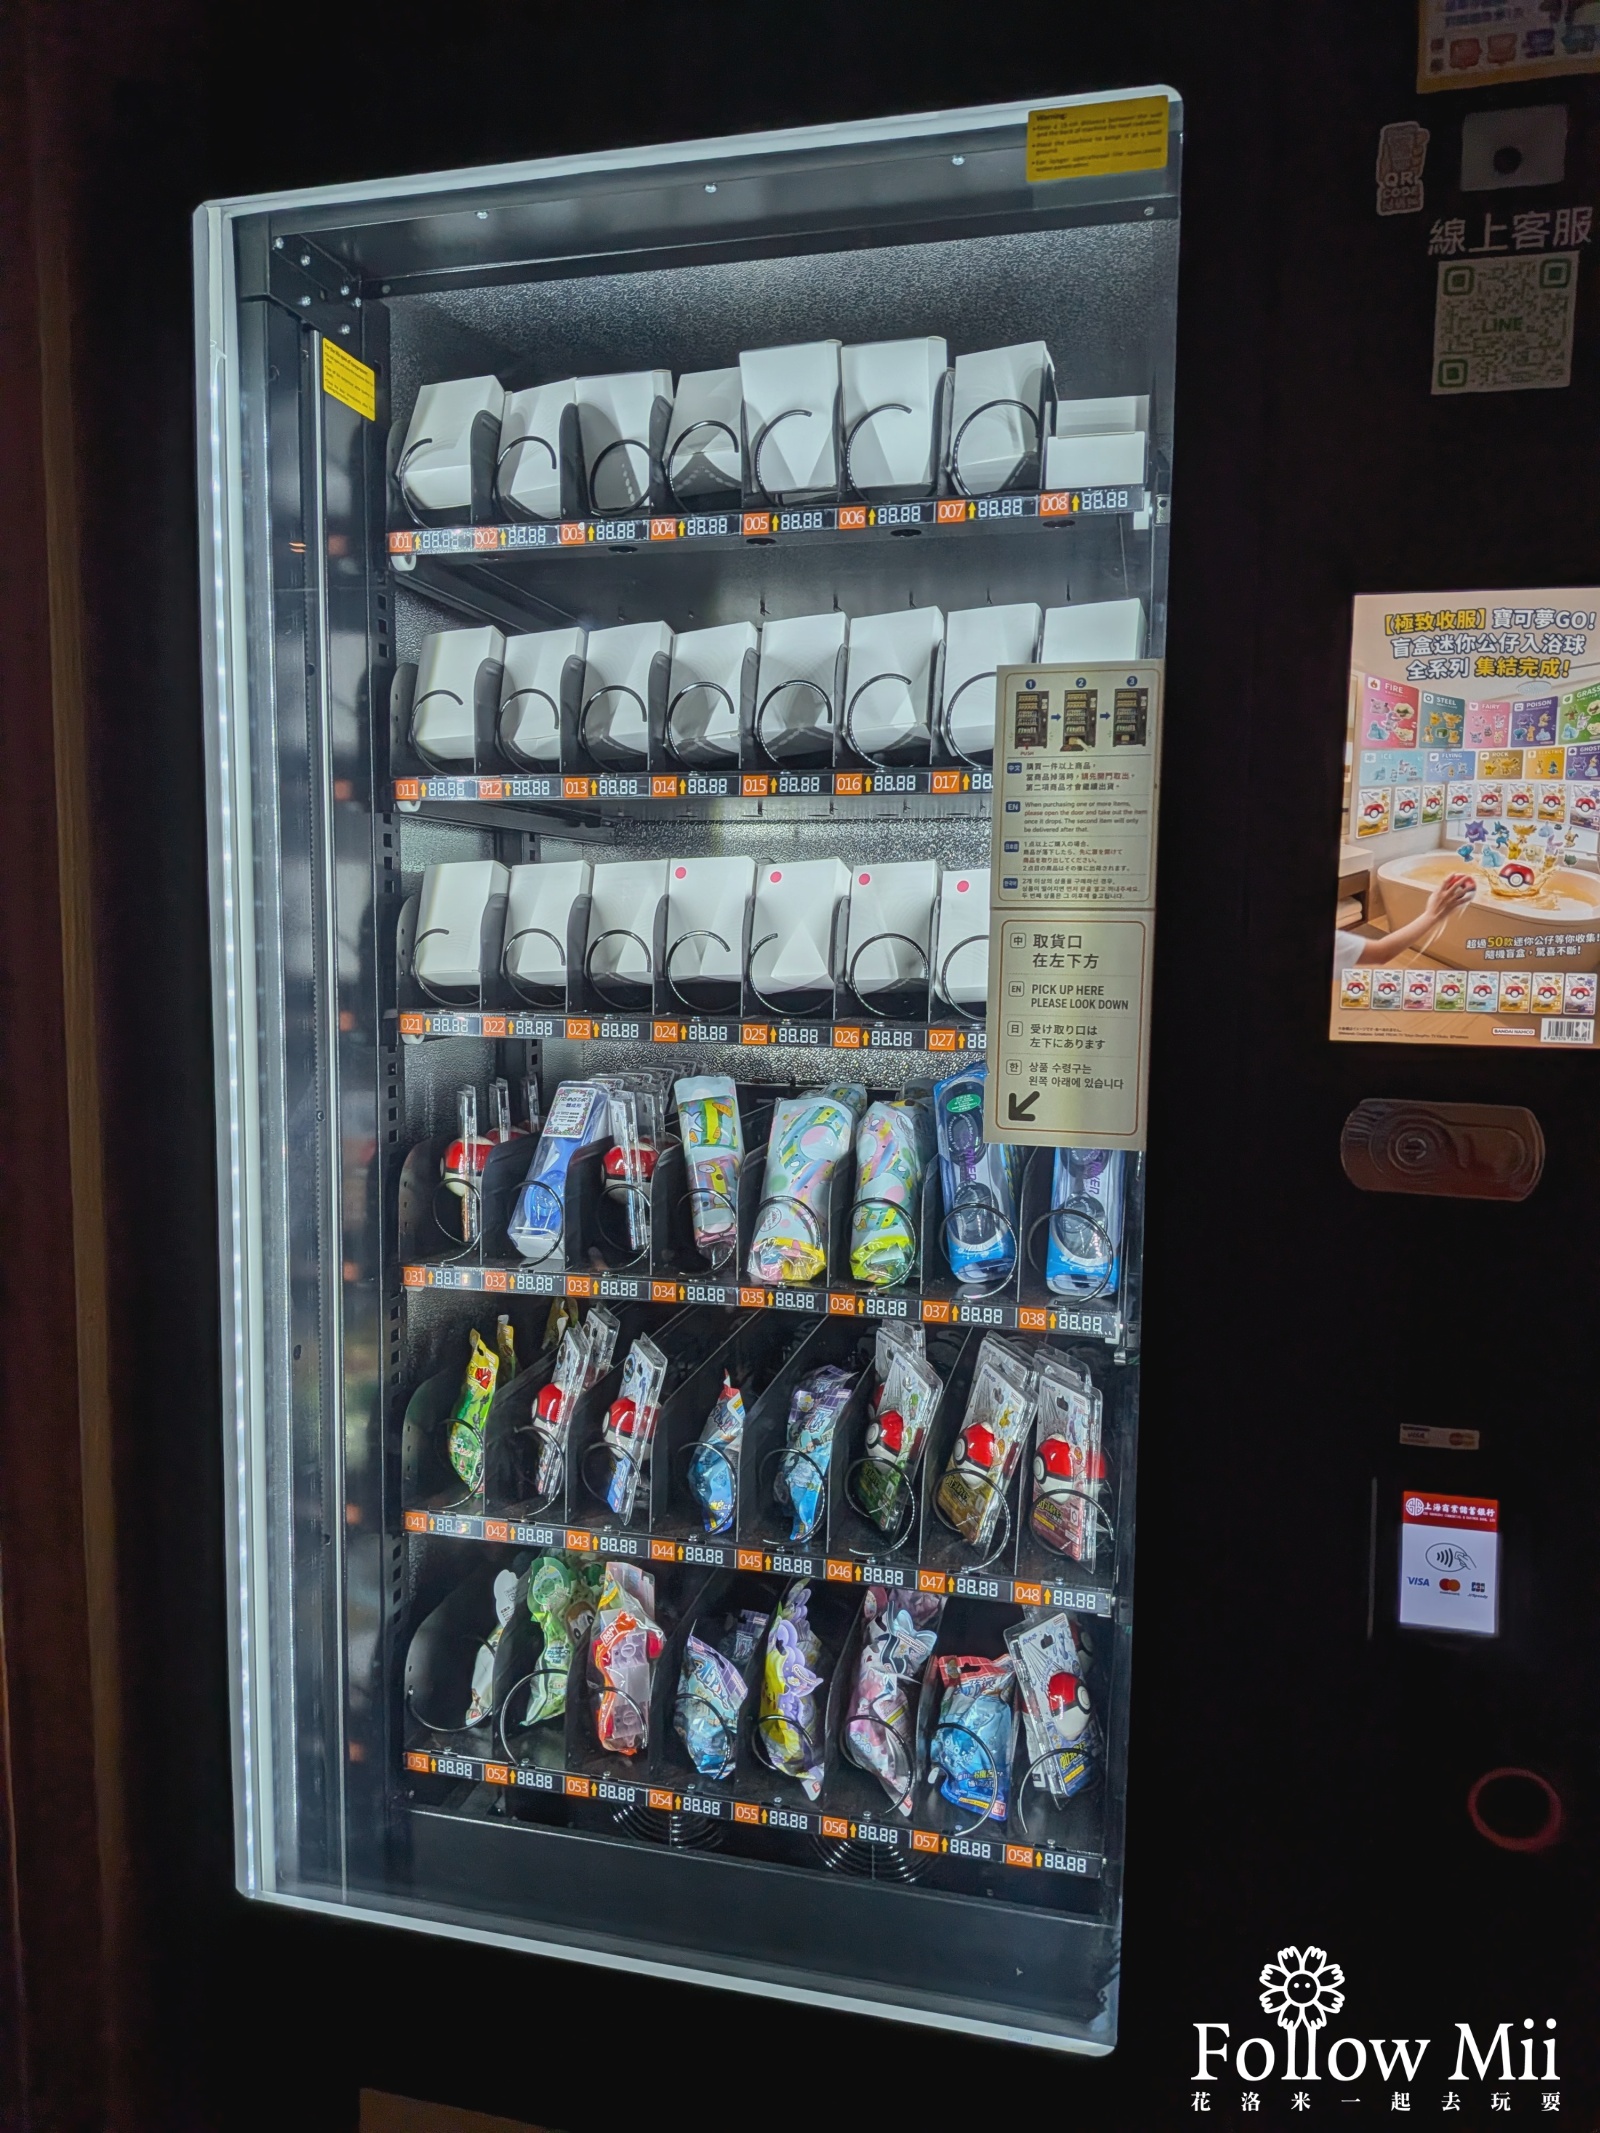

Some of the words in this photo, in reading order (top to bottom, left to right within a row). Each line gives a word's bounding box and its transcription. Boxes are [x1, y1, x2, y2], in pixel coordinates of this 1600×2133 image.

[1385, 172, 1415, 187] QR
[1428, 206, 1593, 256] 線上客服
[1482, 316, 1523, 333] LINE
[1042, 497, 1067, 511] 008
[1082, 491, 1127, 510] 88.88
[939, 504, 963, 519] 007
[978, 499, 1022, 517] 88.88
[745, 517, 768, 530] 005
[781, 513, 822, 530] 88.88
[840, 511, 864, 526] 006
[562, 526, 584, 541] 003
[652, 521, 674, 536] 004
[390, 536, 411, 548] 001
[475, 529, 497, 544] 002
[1385, 608, 1486, 636] 【極致收服】
[1492, 608, 1596, 631] 寶可夢GO!
[1391, 633, 1586, 659] 盲盒迷你公仔入浴球
[1406, 657, 1470, 681] 全系列
[1474, 657, 1571, 679] 集結完成!
[1385, 683, 1403, 694] FIRE
[1436, 696, 1456, 706] STEEL
[1526, 699, 1551, 708] POISON
[480, 783, 502, 795] 012
[566, 782, 587, 794] 013
[599, 780, 637, 794] 88.88
[653, 781, 675, 793] 014
[744, 779, 766, 792] 015
[780, 777, 819, 792] 88.88
[837, 778, 860, 790] 016
[934, 776, 957, 789] 017
[397, 784, 417, 796] 011
[1013, 936, 1023, 946] 中
[1032, 934, 1082, 949] 取貨口
[1032, 953, 1099, 969] 在左下方
[1032, 984, 1057, 995] PICK
[1059, 985, 1074, 995] UP
[1076, 985, 1104, 996] HERE
[1031, 998, 1067, 1009] PLEASE
[1069, 999, 1096, 1009] LOOK
[1098, 1000, 1129, 1010] DOWN
[401, 1019, 420, 1031] 021
[484, 1021, 504, 1033] 022
[568, 1023, 589, 1036] 023
[602, 1024, 638, 1038] 88.88
[655, 1025, 676, 1038] 024
[1011, 1025, 1019, 1033] 日
[1030, 1024, 1098, 1036] 受け取り口は
[744, 1028, 766, 1041] 025
[779, 1028, 818, 1043] 88.88
[836, 1031, 858, 1044] 026
[930, 1034, 953, 1047] 027
[1029, 1038, 1106, 1049] 左下にあります
[1009, 1062, 1019, 1073] 한
[1029, 1063, 1048, 1073] 상품
[1052, 1063, 1092, 1075] 수령구는
[1029, 1076, 1048, 1087] 왼쪽
[1052, 1076, 1081, 1088] 아래에
[1084, 1077, 1124, 1089] 있습니다
[404, 1271, 425, 1283] 031
[485, 1274, 506, 1288] 032
[568, 1279, 589, 1293] 033
[654, 1284, 675, 1298] 034
[741, 1289, 764, 1304] 035
[776, 1292, 814, 1308] 88.88
[831, 1298, 853, 1311] 036
[924, 1304, 947, 1318] 037
[961, 1306, 1002, 1324] 88.88
[1020, 1312, 1044, 1326] 038
[1059, 1314, 1101, 1332] 88.88
[406, 1515, 426, 1529] 041
[487, 1524, 507, 1538] 042
[568, 1534, 589, 1547] 043
[653, 1543, 674, 1557] 044
[740, 1553, 761, 1567] 045
[773, 1557, 812, 1575] 88.88
[829, 1564, 851, 1578] 046
[921, 1574, 944, 1589] 047
[957, 1578, 998, 1597] 88.88
[1407, 1577, 1430, 1586] VISA
[1016, 1586, 1039, 1602] 048
[408, 1756, 428, 1769] 051
[487, 1767, 506, 1781] 052
[568, 1779, 588, 1793] 053
[599, 1783, 635, 1802] 88.88
[651, 1792, 671, 1807] 054
[737, 1806, 758, 1820] 055
[769, 1810, 807, 1829] 88.88
[824, 1820, 846, 1835] 056
[914, 1834, 937, 1849] 057
[950, 1838, 990, 1858] 88.88
[1008, 1848, 1031, 1863] 058
